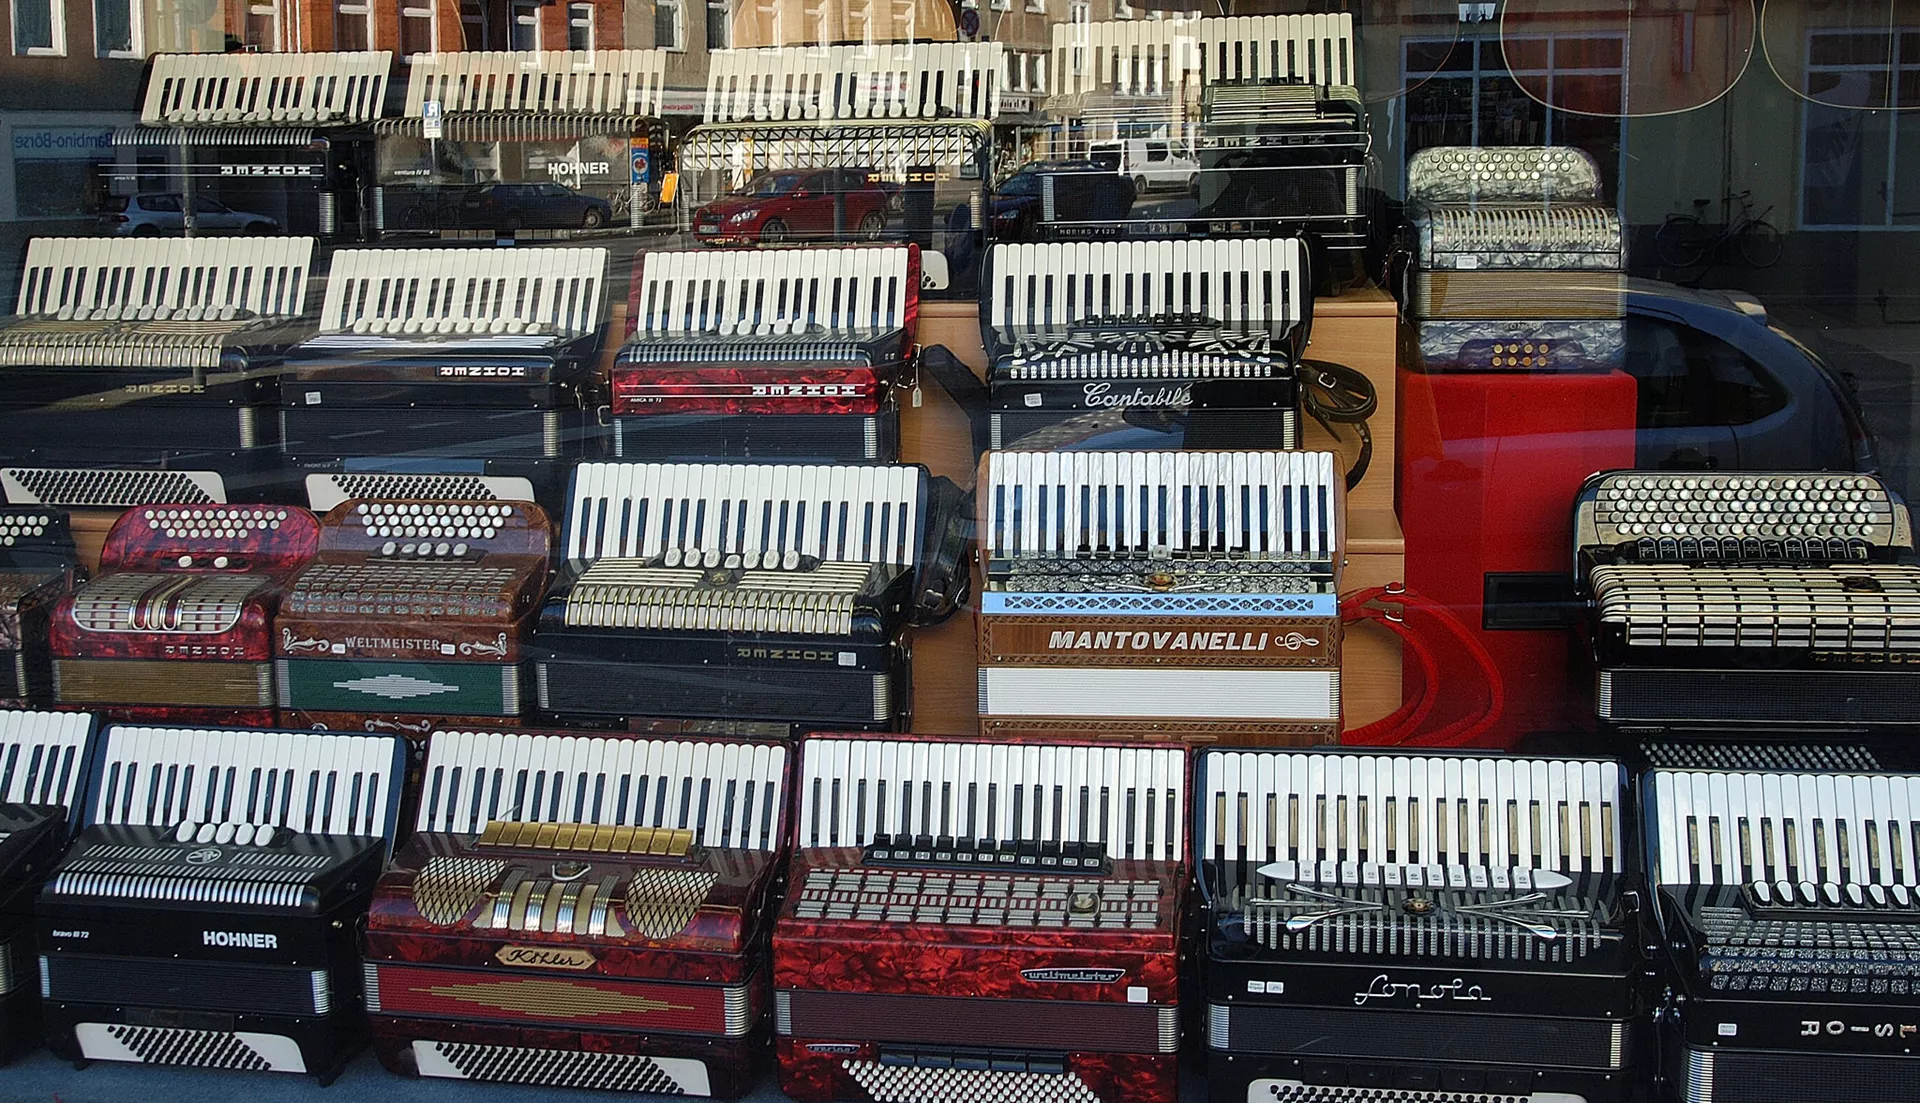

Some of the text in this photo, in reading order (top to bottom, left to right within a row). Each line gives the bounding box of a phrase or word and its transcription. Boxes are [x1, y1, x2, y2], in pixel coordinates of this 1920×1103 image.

[221, 166, 310, 175] HOHNER
[548, 162, 609, 175] HOHNER
[440, 366, 525, 377] HOHNER
[125, 385, 205, 394] HOHNER
[752, 385, 856, 396] HOHNER
[345, 636, 441, 651] WELTMEISTER
[1048, 631, 1268, 651] MANTOVANELLI
[165, 645, 244, 656] HOHNER
[737, 648, 834, 661] HOHNER
[52, 929, 73, 937] bravo
[203, 931, 277, 949] HOHNER
